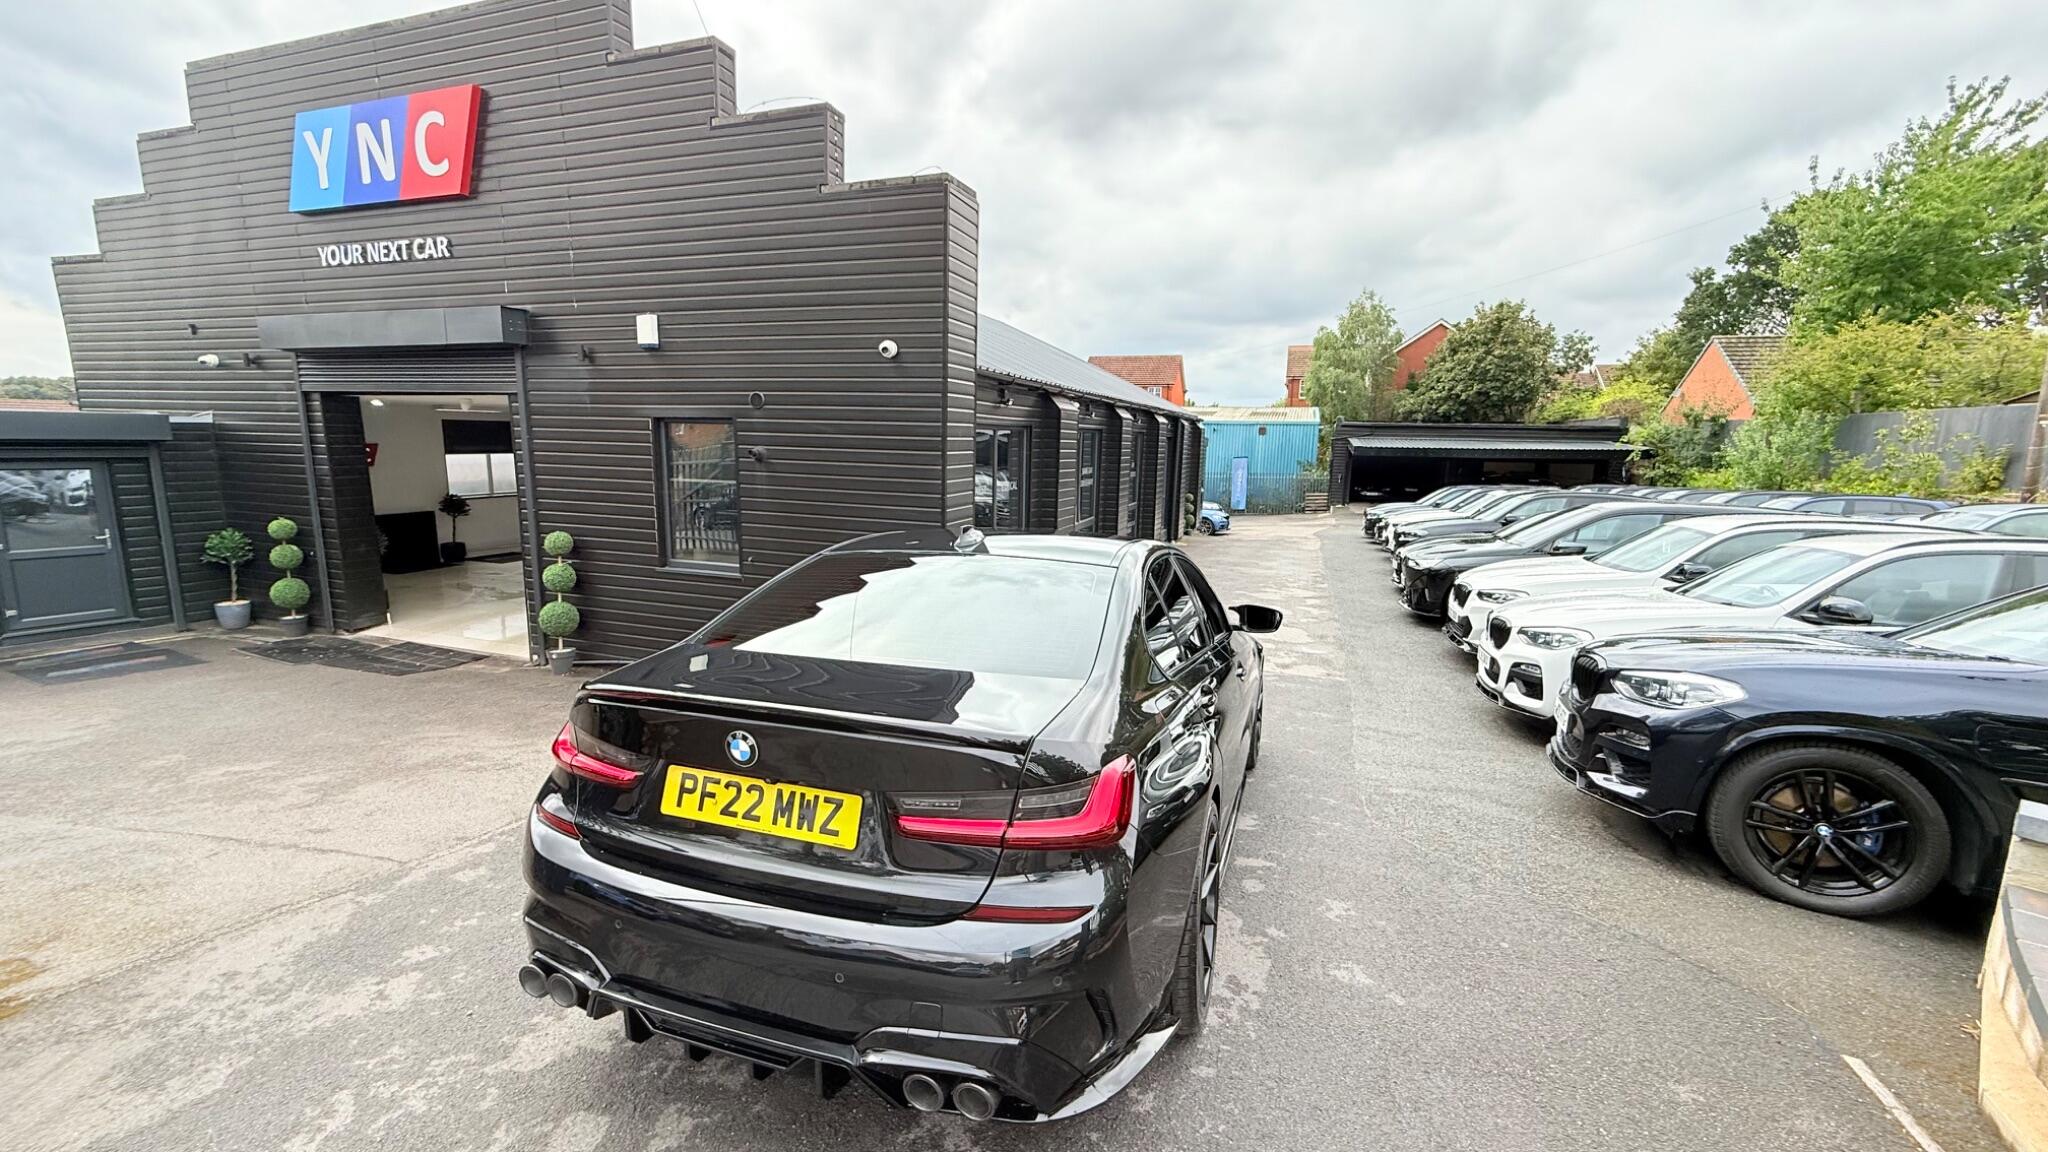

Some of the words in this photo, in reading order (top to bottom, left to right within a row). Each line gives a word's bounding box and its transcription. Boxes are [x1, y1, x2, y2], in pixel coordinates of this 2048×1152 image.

[303, 111, 449, 189] YNC
[317, 244, 364, 266] YOUR
[366, 240, 410, 263] NEXT
[413, 236, 450, 259] CAR
[676, 773, 764, 822] PF22
[772, 788, 844, 837] MWZ
